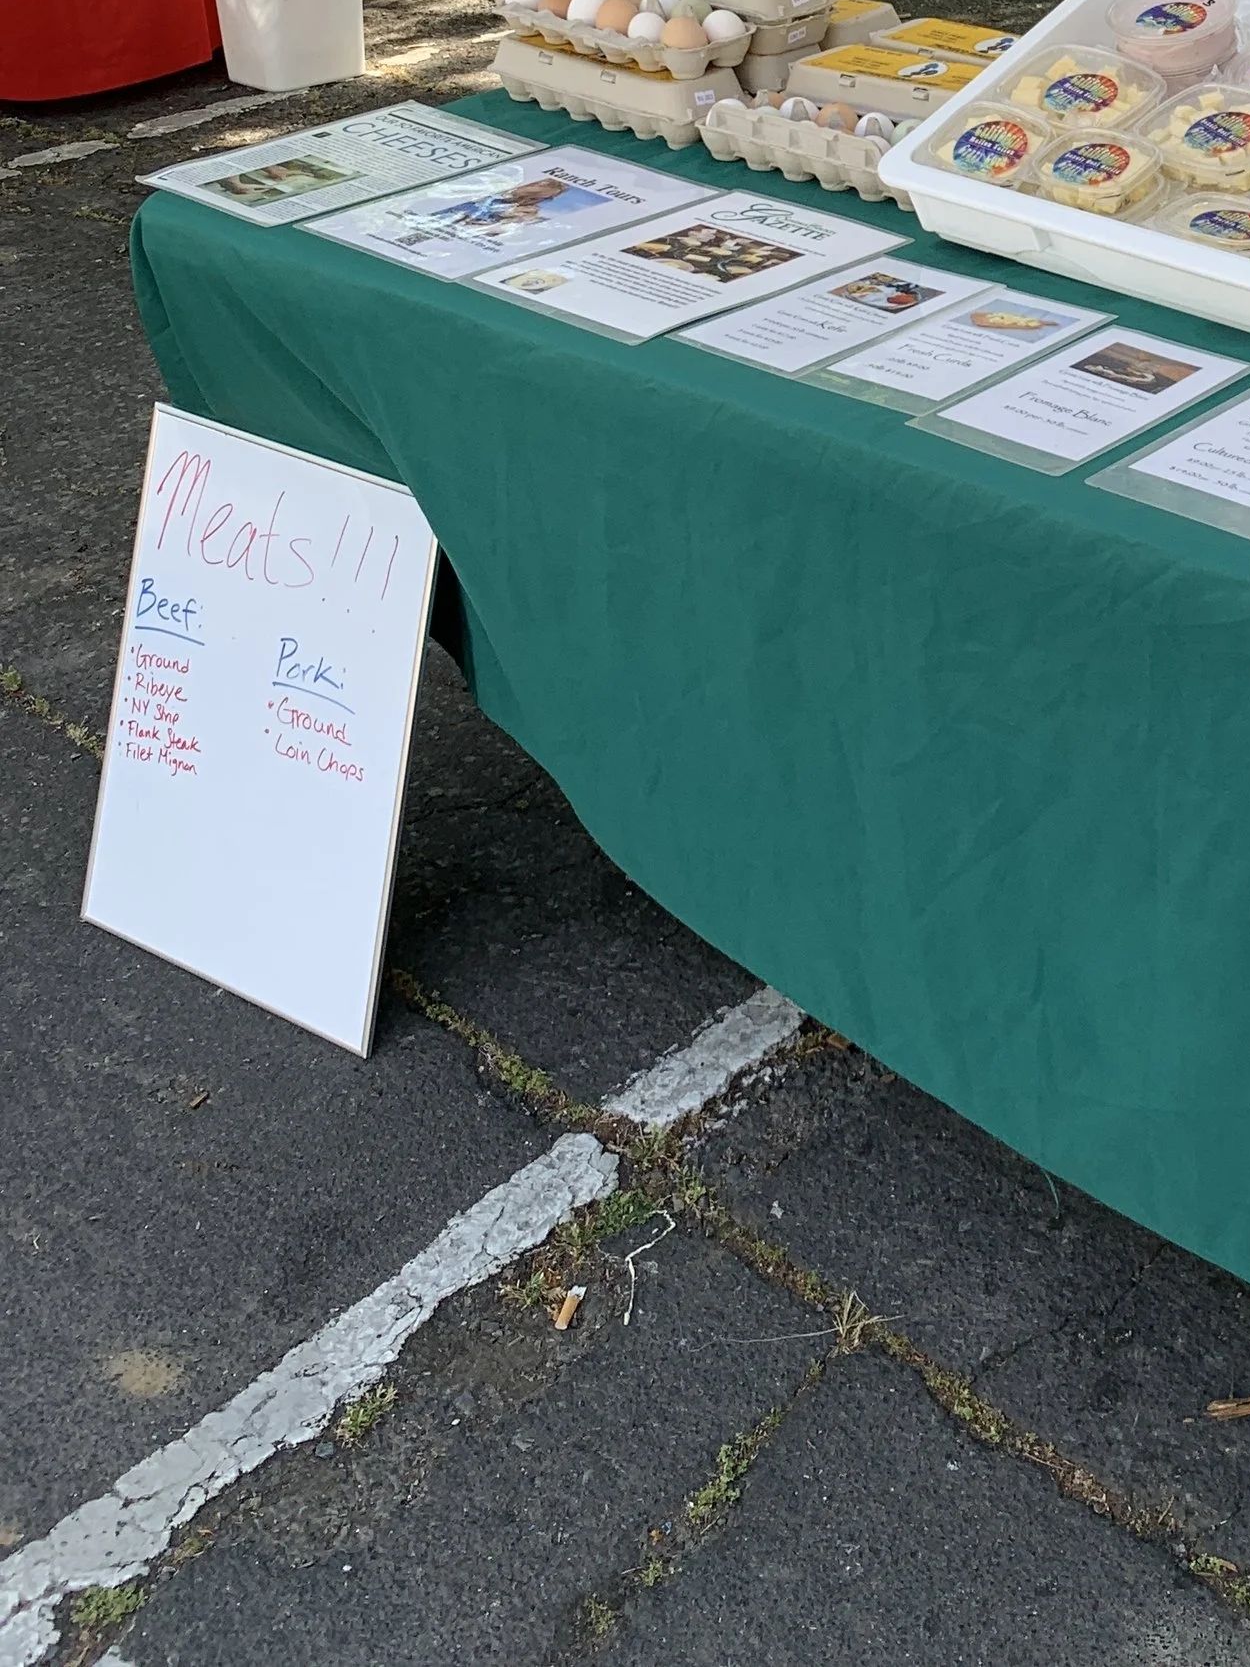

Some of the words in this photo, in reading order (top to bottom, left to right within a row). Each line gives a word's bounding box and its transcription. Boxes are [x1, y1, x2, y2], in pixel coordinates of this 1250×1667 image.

[342, 122, 482, 170] CHEESES
[542, 166, 598, 188] Ranch
[596, 183, 647, 205] Tours
[1018, 391, 1074, 415] Fromage
[1071, 409, 1113, 427] Blanc
[156, 448, 401, 634] Meats!!!
[136, 577, 204, 631] Beef:
[135, 644, 190, 674] Ground
[276, 637, 347, 689] Pork:
[132, 697, 150, 716] NY
[134, 671, 188, 704] Ribeye
[127, 720, 161, 742] Flank
[164, 727, 202, 753] Steak
[276, 696, 352, 746] Ground
[126, 742, 153, 762] Filet
[157, 748, 198, 777] Mignon
[275, 733, 311, 765] Loin
[316, 747, 365, 782] Chops
